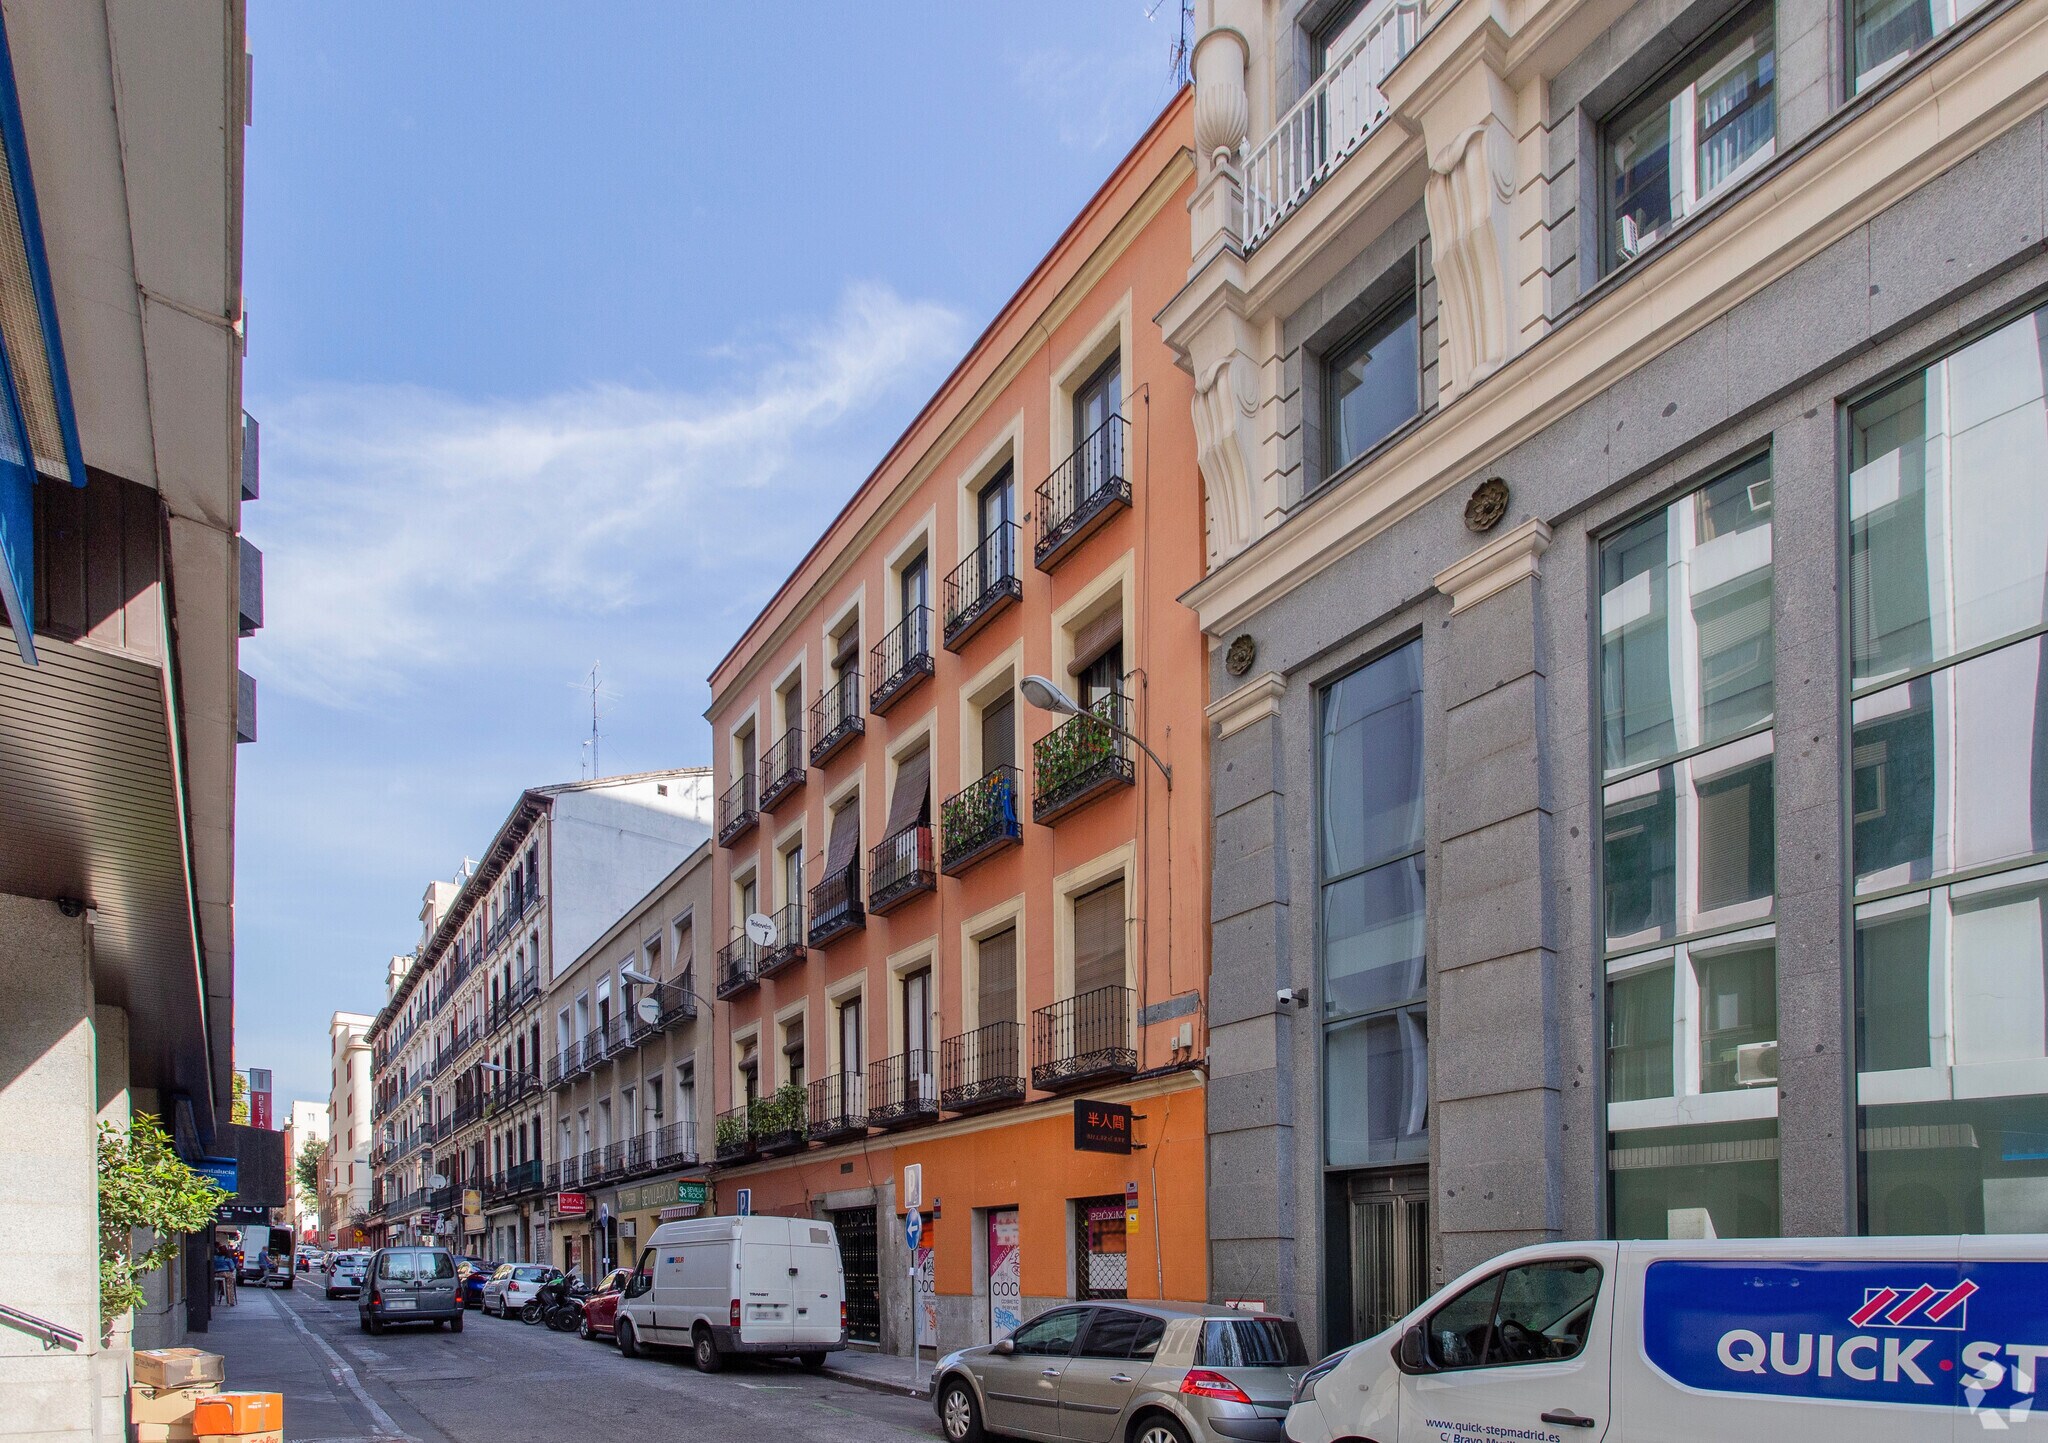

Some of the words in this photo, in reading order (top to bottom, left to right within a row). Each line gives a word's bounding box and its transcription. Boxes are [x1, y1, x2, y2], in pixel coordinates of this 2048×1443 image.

[1088, 1112, 1125, 1131] 半人間
[1425, 1418, 1561, 1443] www.quick-stepmadrid.es
